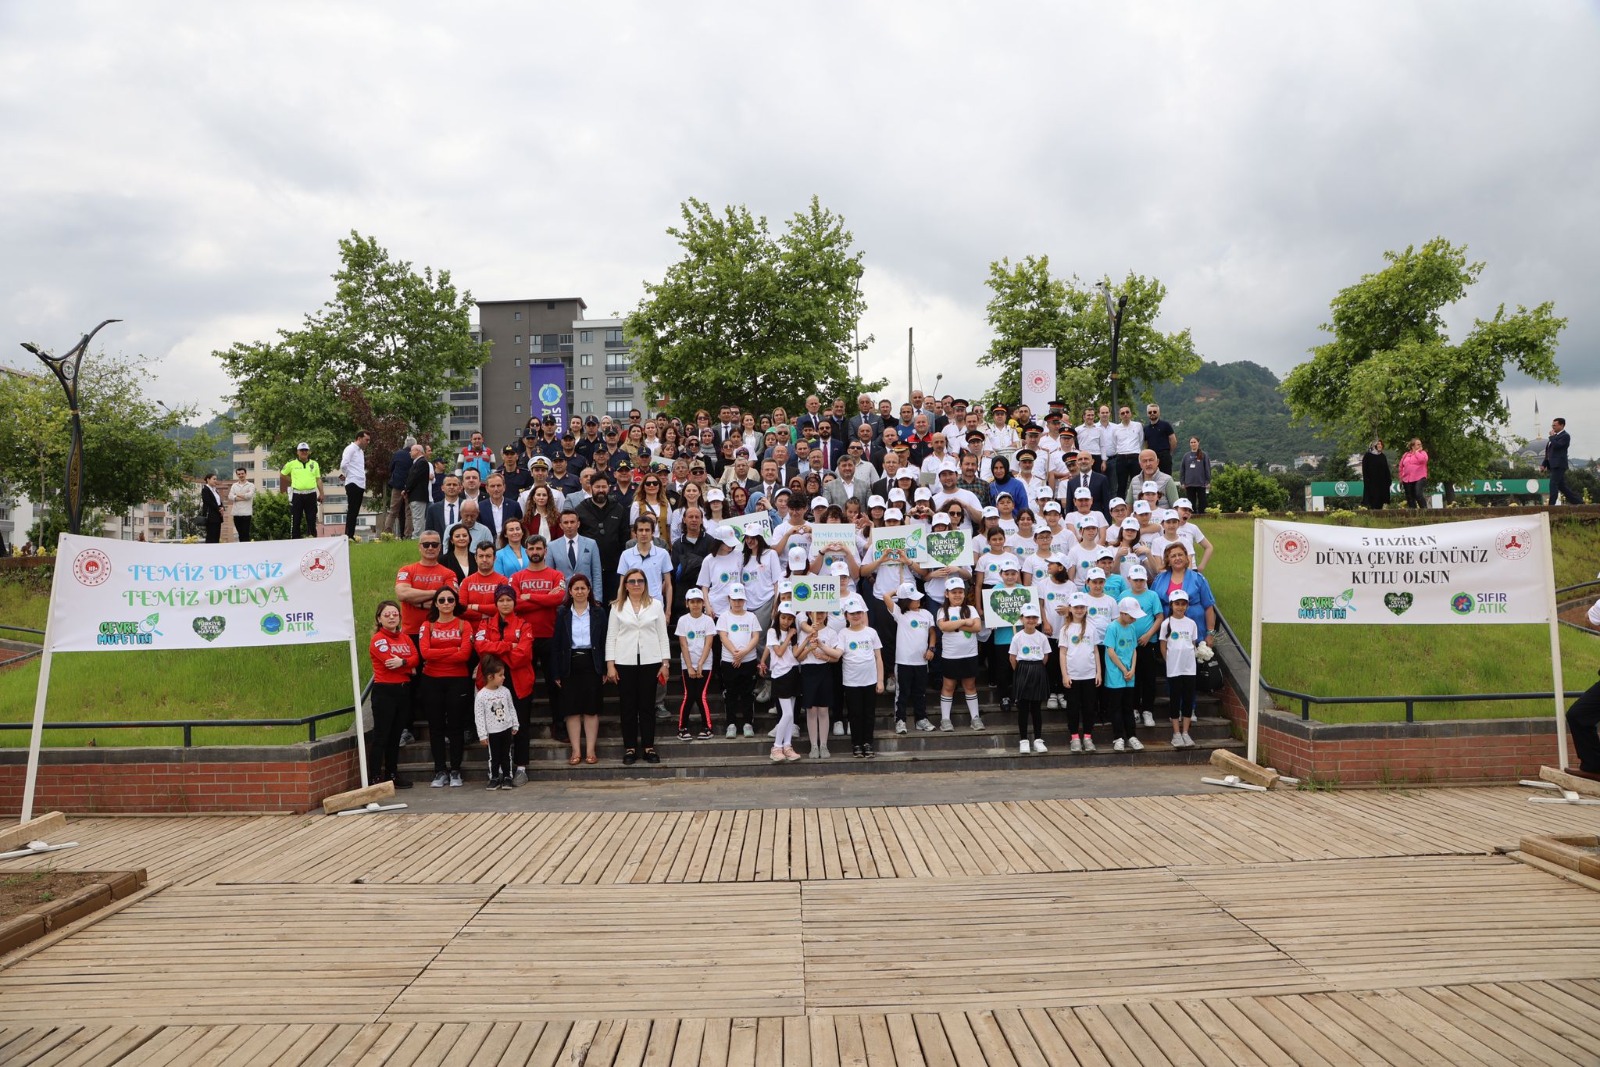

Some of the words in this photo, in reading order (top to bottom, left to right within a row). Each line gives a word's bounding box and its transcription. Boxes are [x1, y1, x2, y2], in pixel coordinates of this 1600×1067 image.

[1361, 536, 1370, 546] 5
[1374, 535, 1438, 547] HAZİRAN
[1315, 548, 1363, 565] DÜNYA
[1368, 550, 1415, 569] ÇEVRE
[1419, 546, 1488, 565] GÜNÜNÜZ
[128, 562, 204, 582] TEMİZ
[209, 560, 283, 581] DENİZ
[1352, 570, 1399, 585] KUTLU
[1403, 570, 1450, 585] OLSUN
[469, 584, 498, 592] AKUT
[521, 580, 551, 589] AKUT
[813, 583, 835, 592] SIFIR
[122, 587, 200, 607] TEMİZ
[205, 585, 289, 608] DÜNYA
[813, 592, 835, 600] ATIK
[1477, 592, 1507, 603] SIFIR
[1478, 603, 1507, 613] ATIK
[286, 612, 314, 622] SIFIR
[287, 622, 315, 632] ATIK
